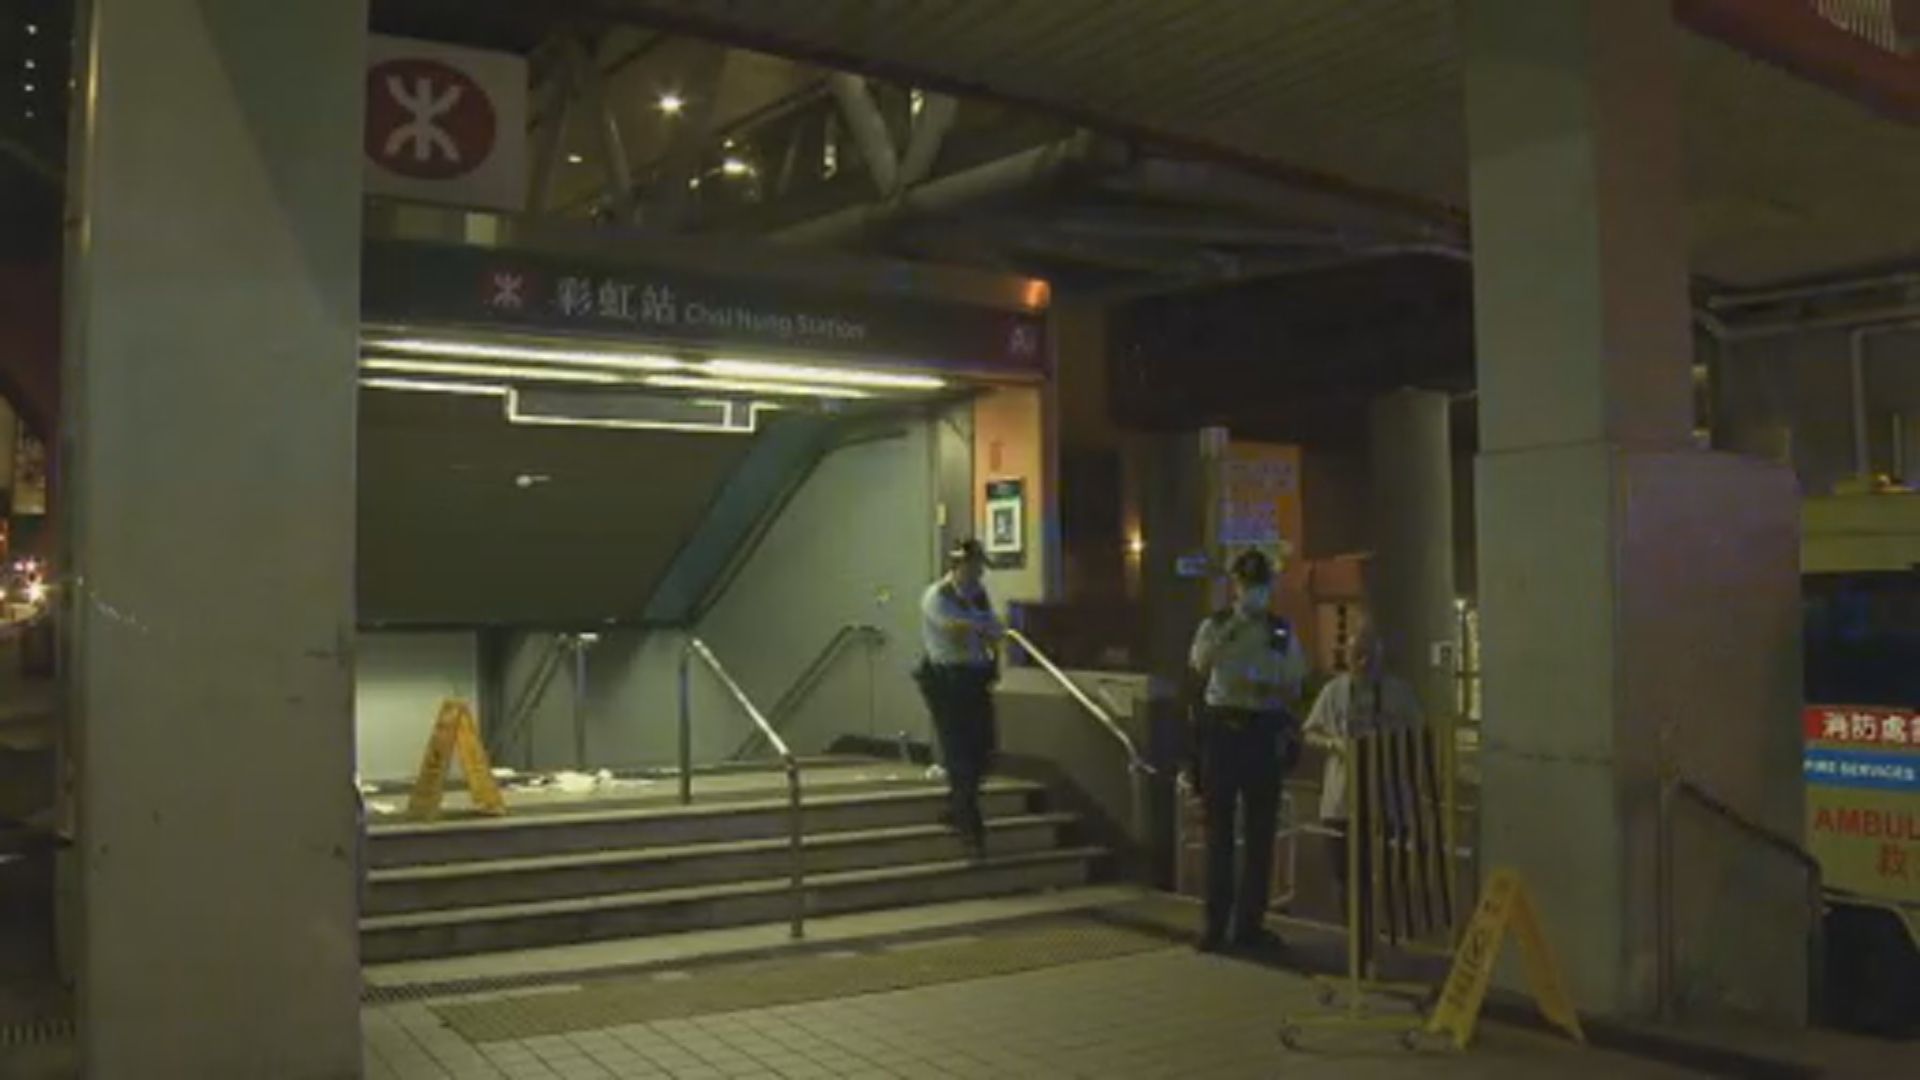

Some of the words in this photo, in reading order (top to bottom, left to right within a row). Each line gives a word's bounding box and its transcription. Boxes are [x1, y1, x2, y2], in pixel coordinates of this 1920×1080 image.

[556, 276, 676, 324] 彩虹站
[797, 312, 867, 341] Station
[1803, 758, 1837, 776] FIRE
[1840, 761, 1916, 783] SERVICES
[1876, 842, 1920, 884] 救
